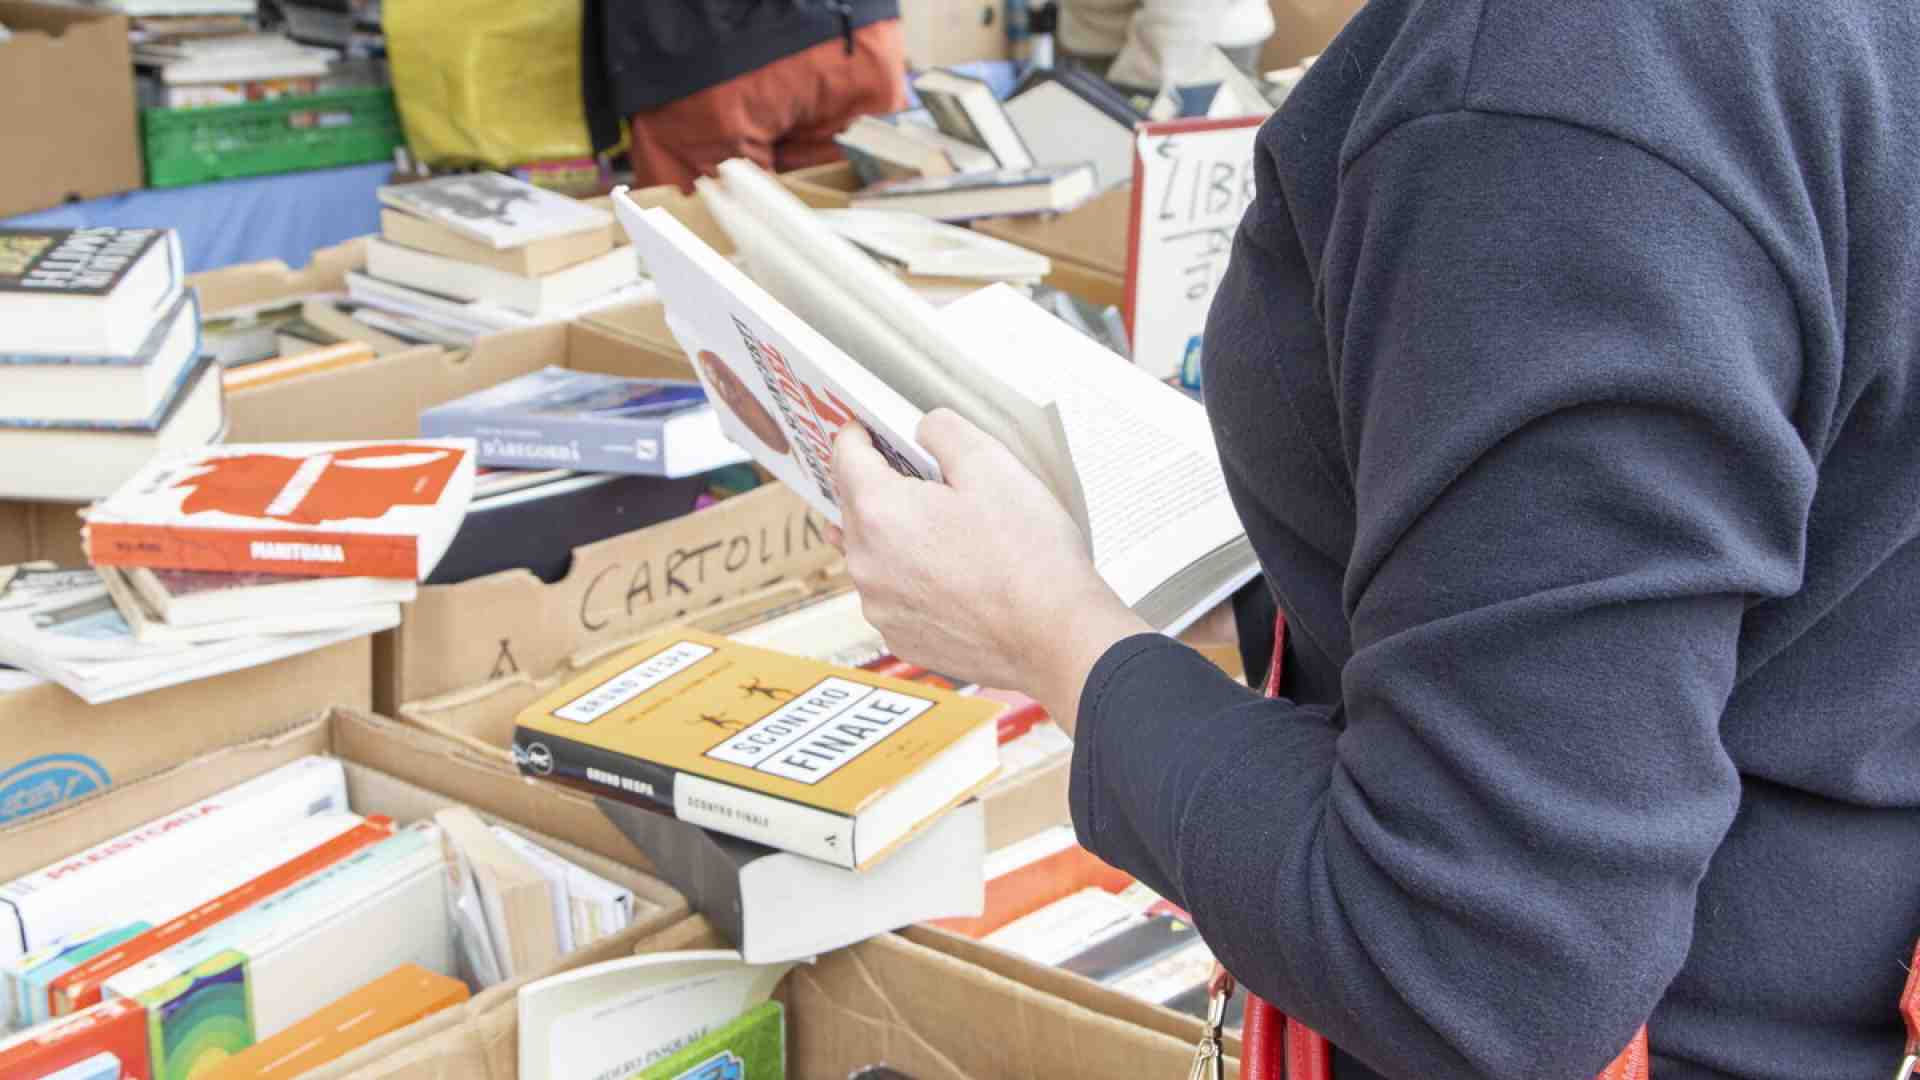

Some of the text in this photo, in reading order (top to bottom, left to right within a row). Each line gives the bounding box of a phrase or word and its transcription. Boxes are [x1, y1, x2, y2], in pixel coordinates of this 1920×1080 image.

[732, 687, 851, 755] SCONTRO
[784, 699, 911, 772] FINALE
[585, 766, 655, 797] BRUNO VESPA
[687, 795, 770, 828] SCONTRO FINALE
